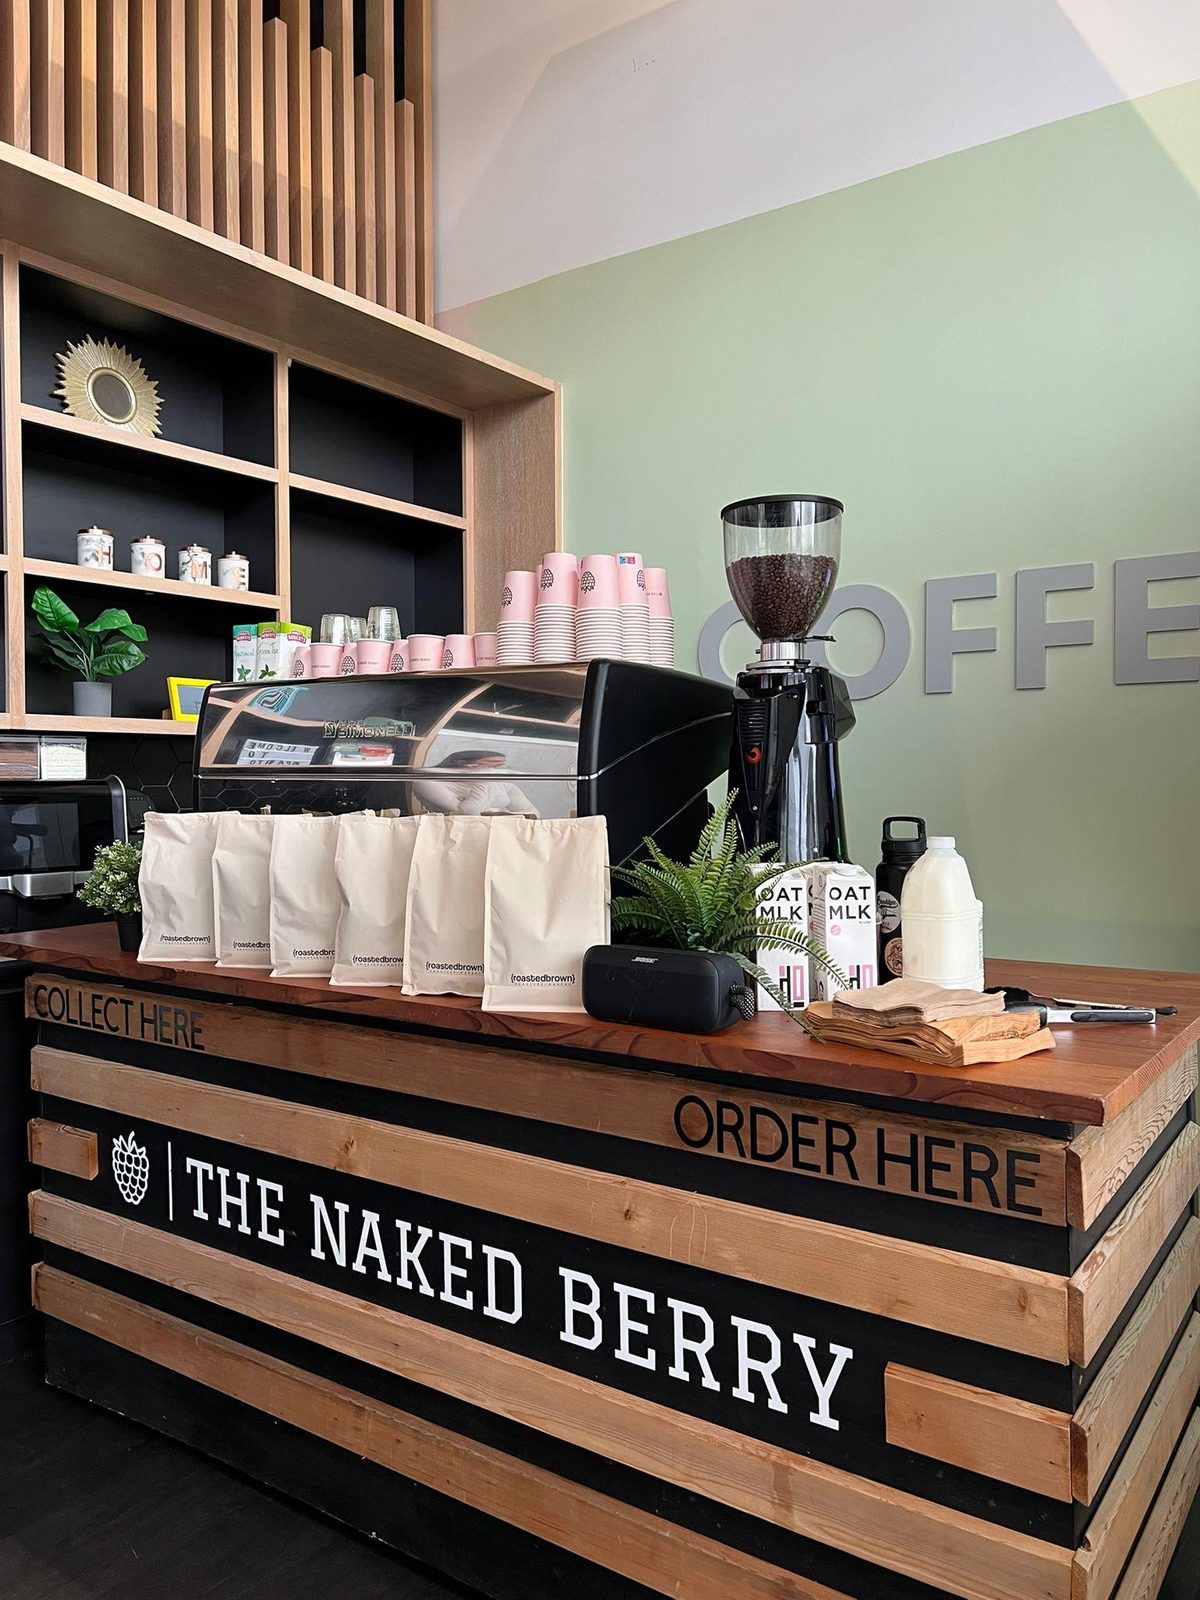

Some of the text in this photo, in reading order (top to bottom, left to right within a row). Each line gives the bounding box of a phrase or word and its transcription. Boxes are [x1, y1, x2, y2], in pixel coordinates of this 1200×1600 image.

[829, 886, 871, 901] OAT
[760, 906, 803, 920] MLK
[829, 904, 871, 920] MLK
[233, 941, 271, 949] {roastedbro
[352, 955, 404, 963] {roastedbrow
[510, 973, 576, 984] {roastedbrown}
[34, 984, 205, 1051] COLLECT HERE
[673, 1094, 1043, 1217] ORDER HERE
[186, 1157, 853, 1431] THE NAKED BERRY
